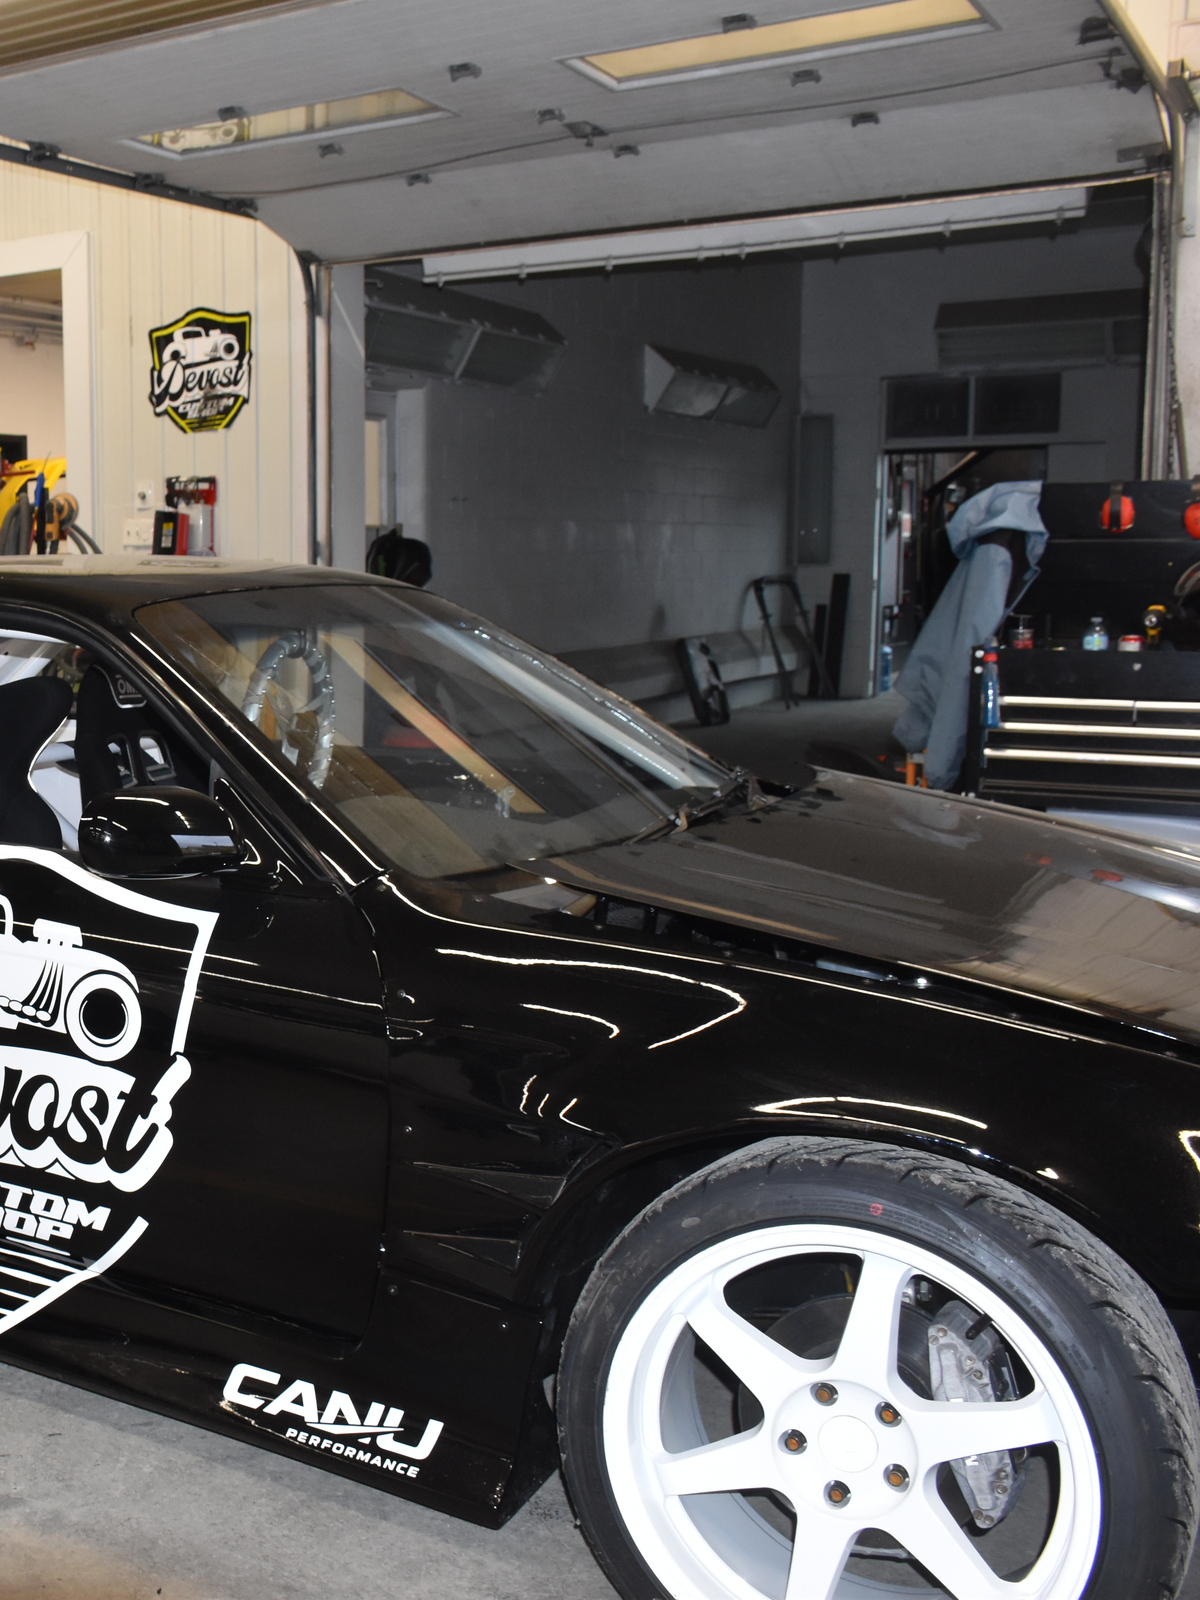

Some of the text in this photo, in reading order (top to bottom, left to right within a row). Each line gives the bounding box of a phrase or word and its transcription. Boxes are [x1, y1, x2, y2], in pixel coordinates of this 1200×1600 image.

[152, 358, 246, 411] Devost
[117, 680, 139, 694] OM
[285, 1428, 420, 1478] PERFORMANCE
